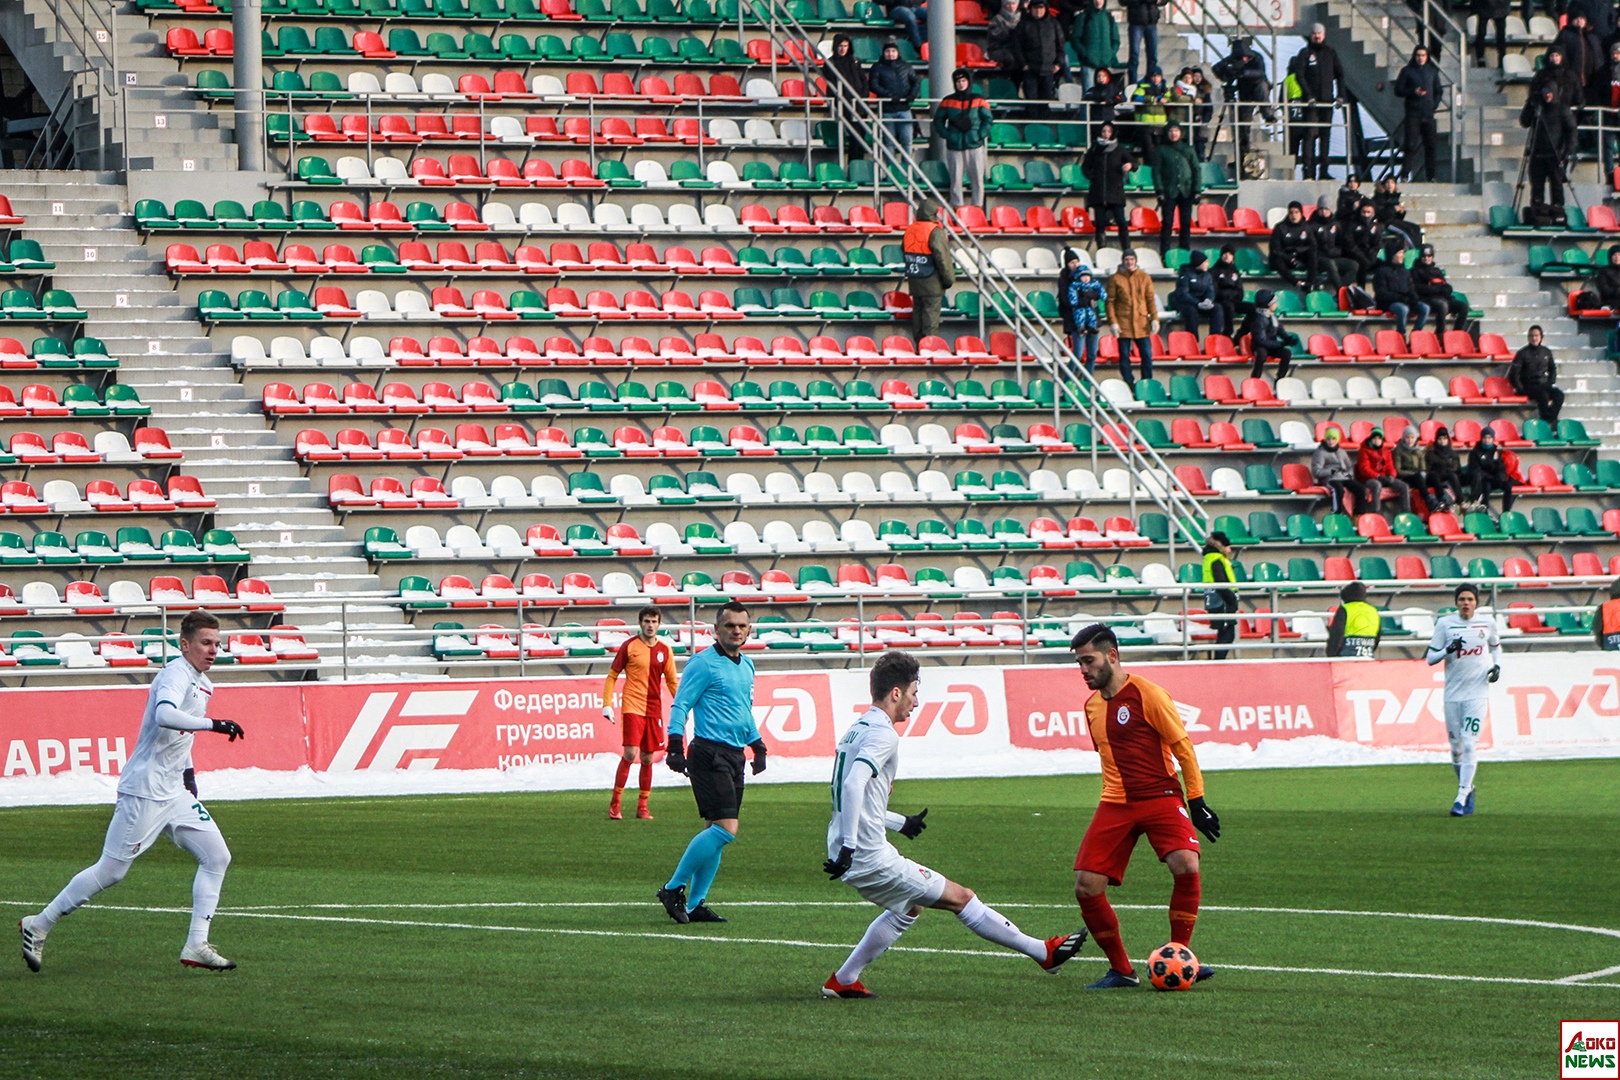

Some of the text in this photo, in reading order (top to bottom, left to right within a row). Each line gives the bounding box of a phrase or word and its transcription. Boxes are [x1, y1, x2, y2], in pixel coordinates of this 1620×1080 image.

[1270, 0, 1283, 21] 3
[1345, 637, 1375, 646] STEWAR
[493, 689, 623, 715] Федеральн
[1028, 704, 1314, 738] САП АРЕНА
[1464, 716, 1480, 732] 76
[496, 722, 595, 747] грузовая
[3, 737, 128, 777] АРЕН
[498, 753, 595, 771] компани
